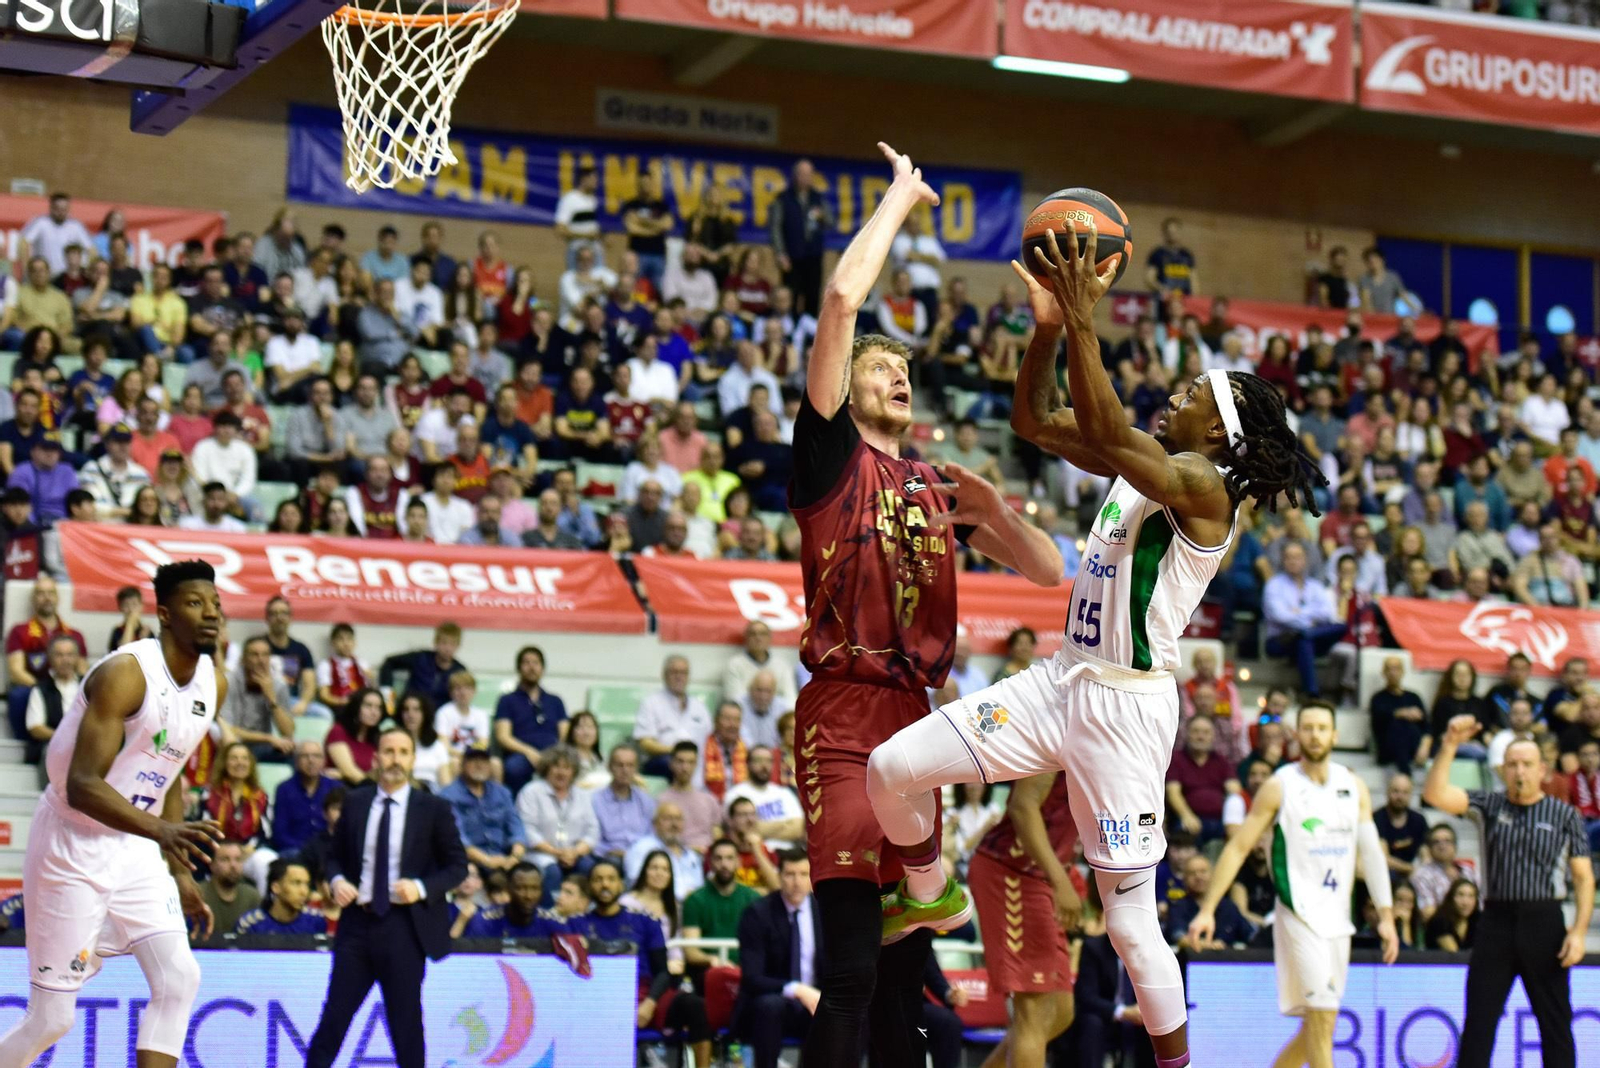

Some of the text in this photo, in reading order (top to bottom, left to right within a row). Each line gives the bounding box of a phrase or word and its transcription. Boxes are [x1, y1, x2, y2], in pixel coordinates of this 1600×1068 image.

[0, 0, 112, 41] sa
[708, 0, 798, 31] Grupo
[1023, 0, 1291, 59] COMPRALAENTRADA
[1424, 46, 1600, 106] GRUPOSUR
[558, 150, 975, 243] UNIVERIDD
[265, 545, 563, 596] Renesur
[280, 583, 437, 606] Combustible
[462, 592, 576, 612] domicilio
[895, 580, 920, 629] 13
[1072, 598, 1102, 648] 55
[1322, 868, 1338, 893] 4
